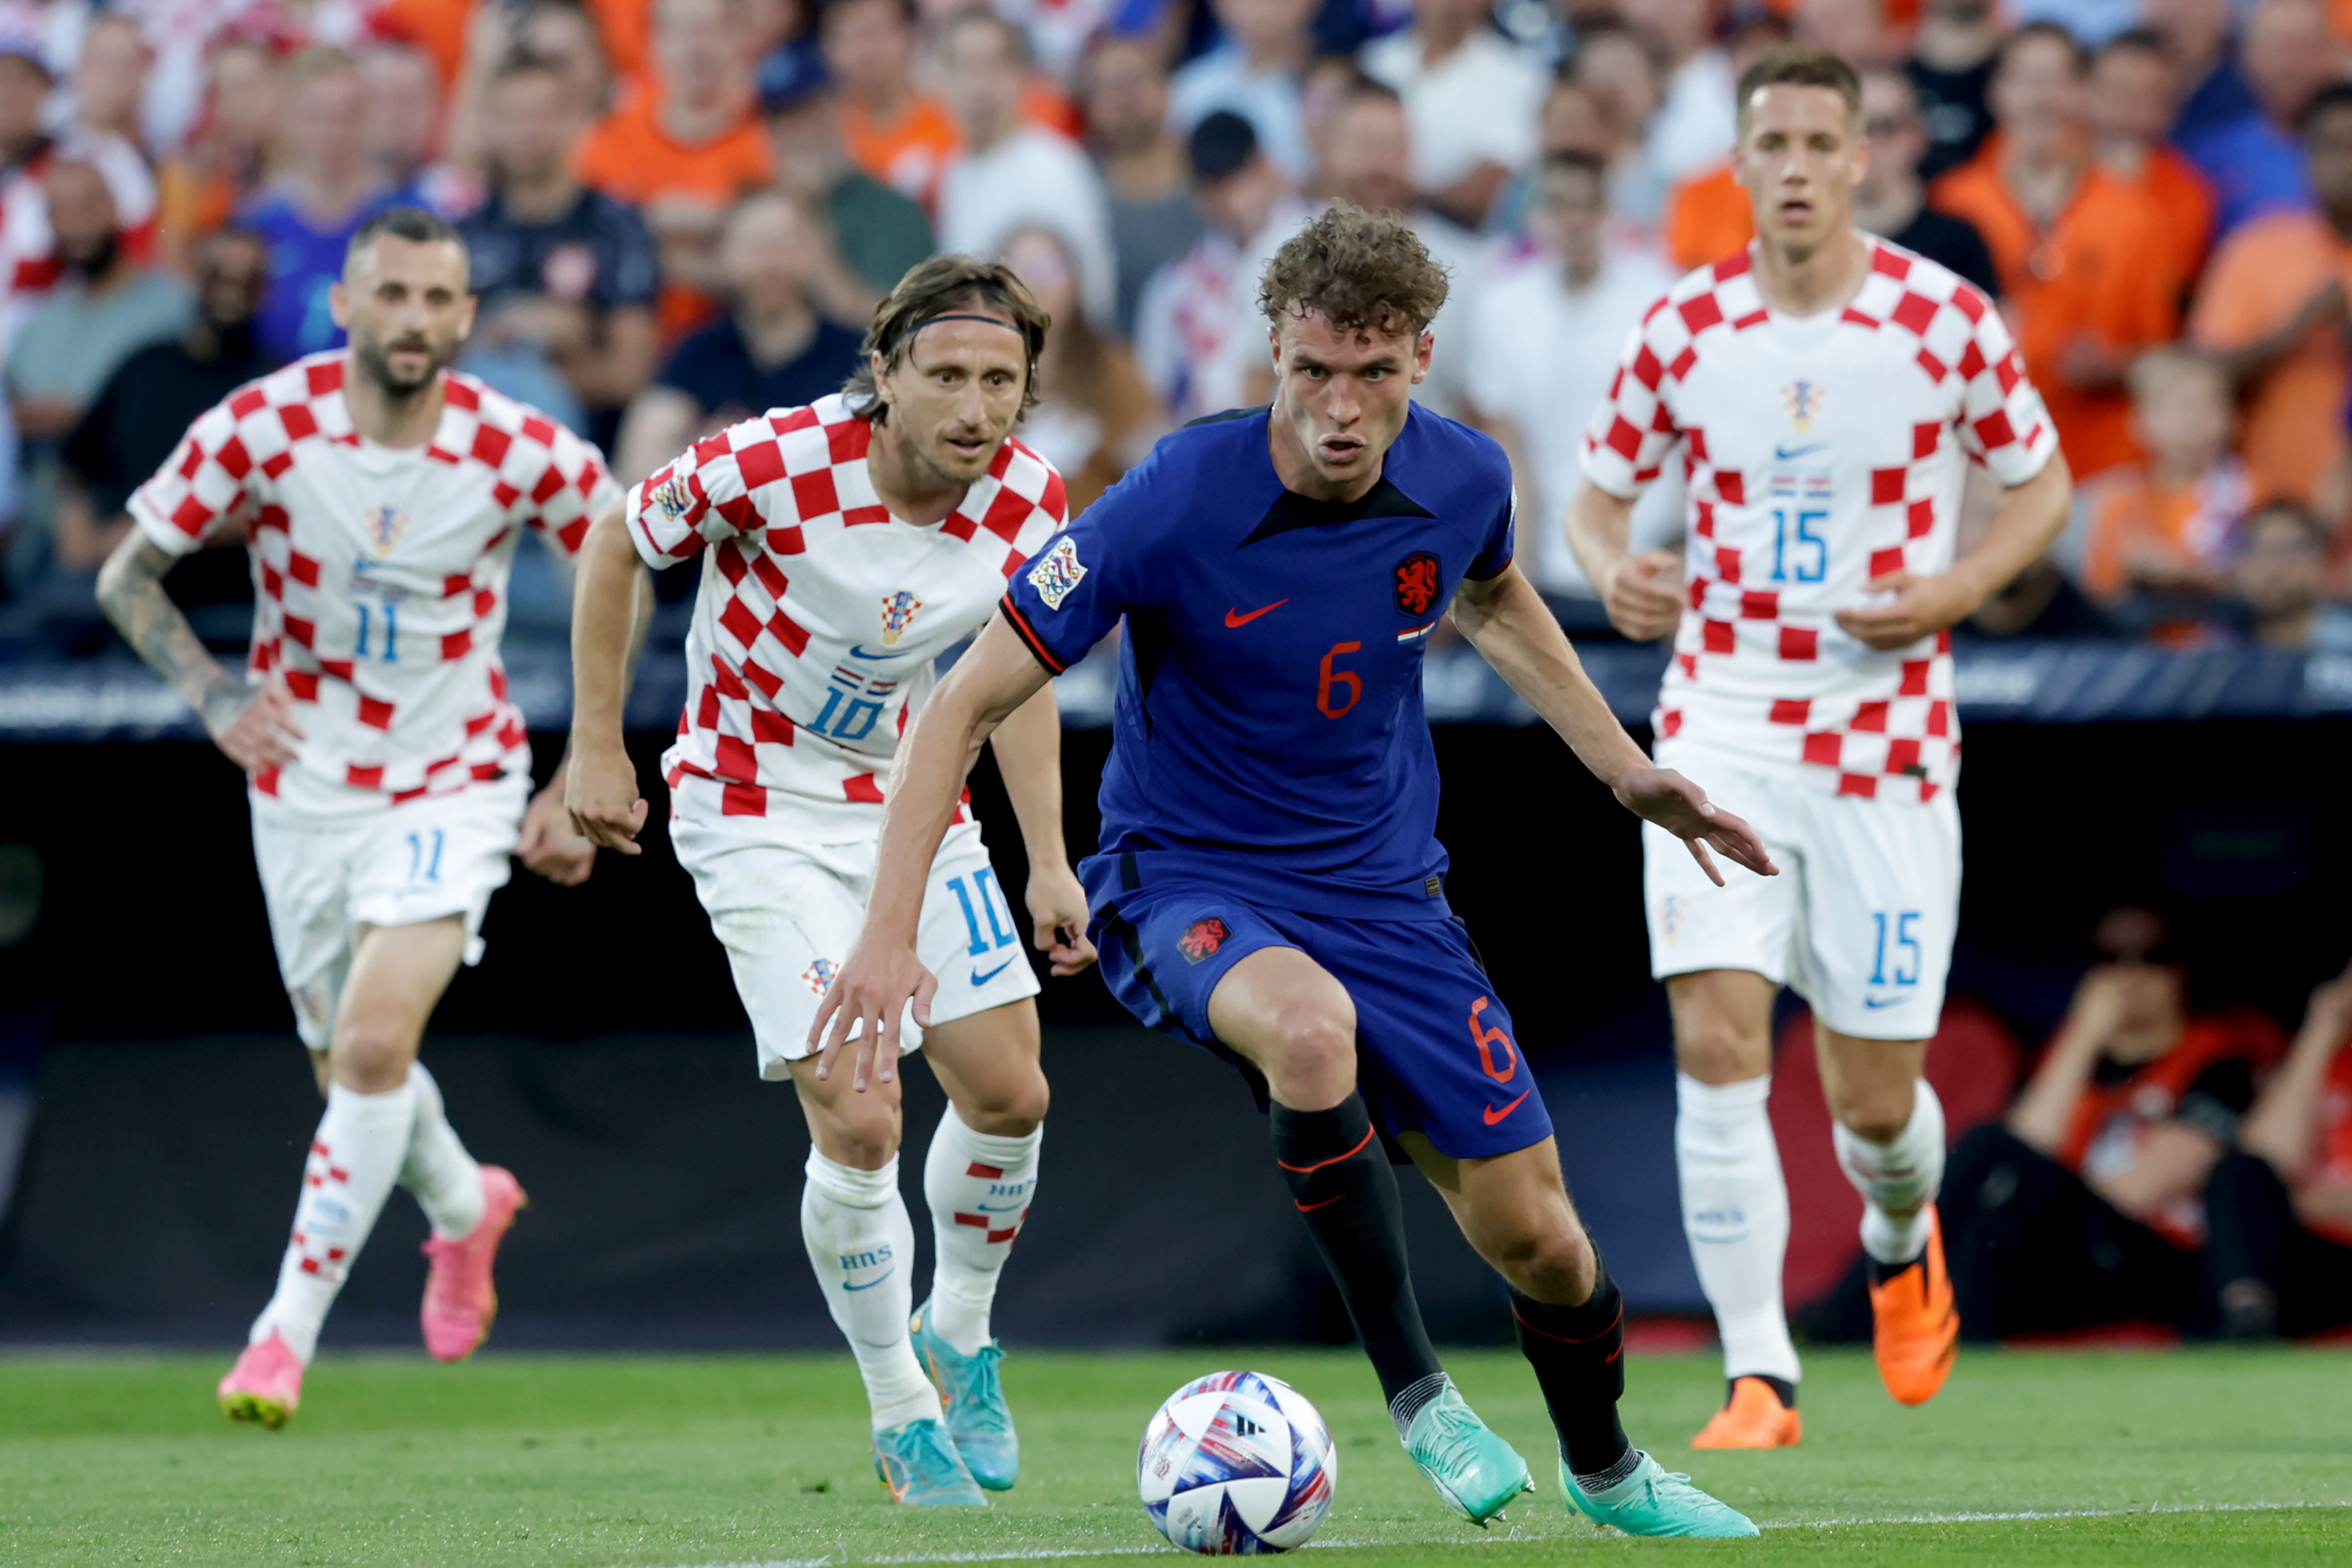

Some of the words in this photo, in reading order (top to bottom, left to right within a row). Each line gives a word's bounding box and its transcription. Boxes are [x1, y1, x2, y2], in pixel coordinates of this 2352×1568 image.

[1771, 510, 1828, 582] 15
[354, 603, 399, 662] 11
[805, 685, 886, 740] 10
[1316, 640, 1363, 720] 6
[405, 828, 443, 883] 11
[946, 864, 1017, 957] 10
[1868, 912, 1922, 986] 15
[1468, 995, 1517, 1084] 6
